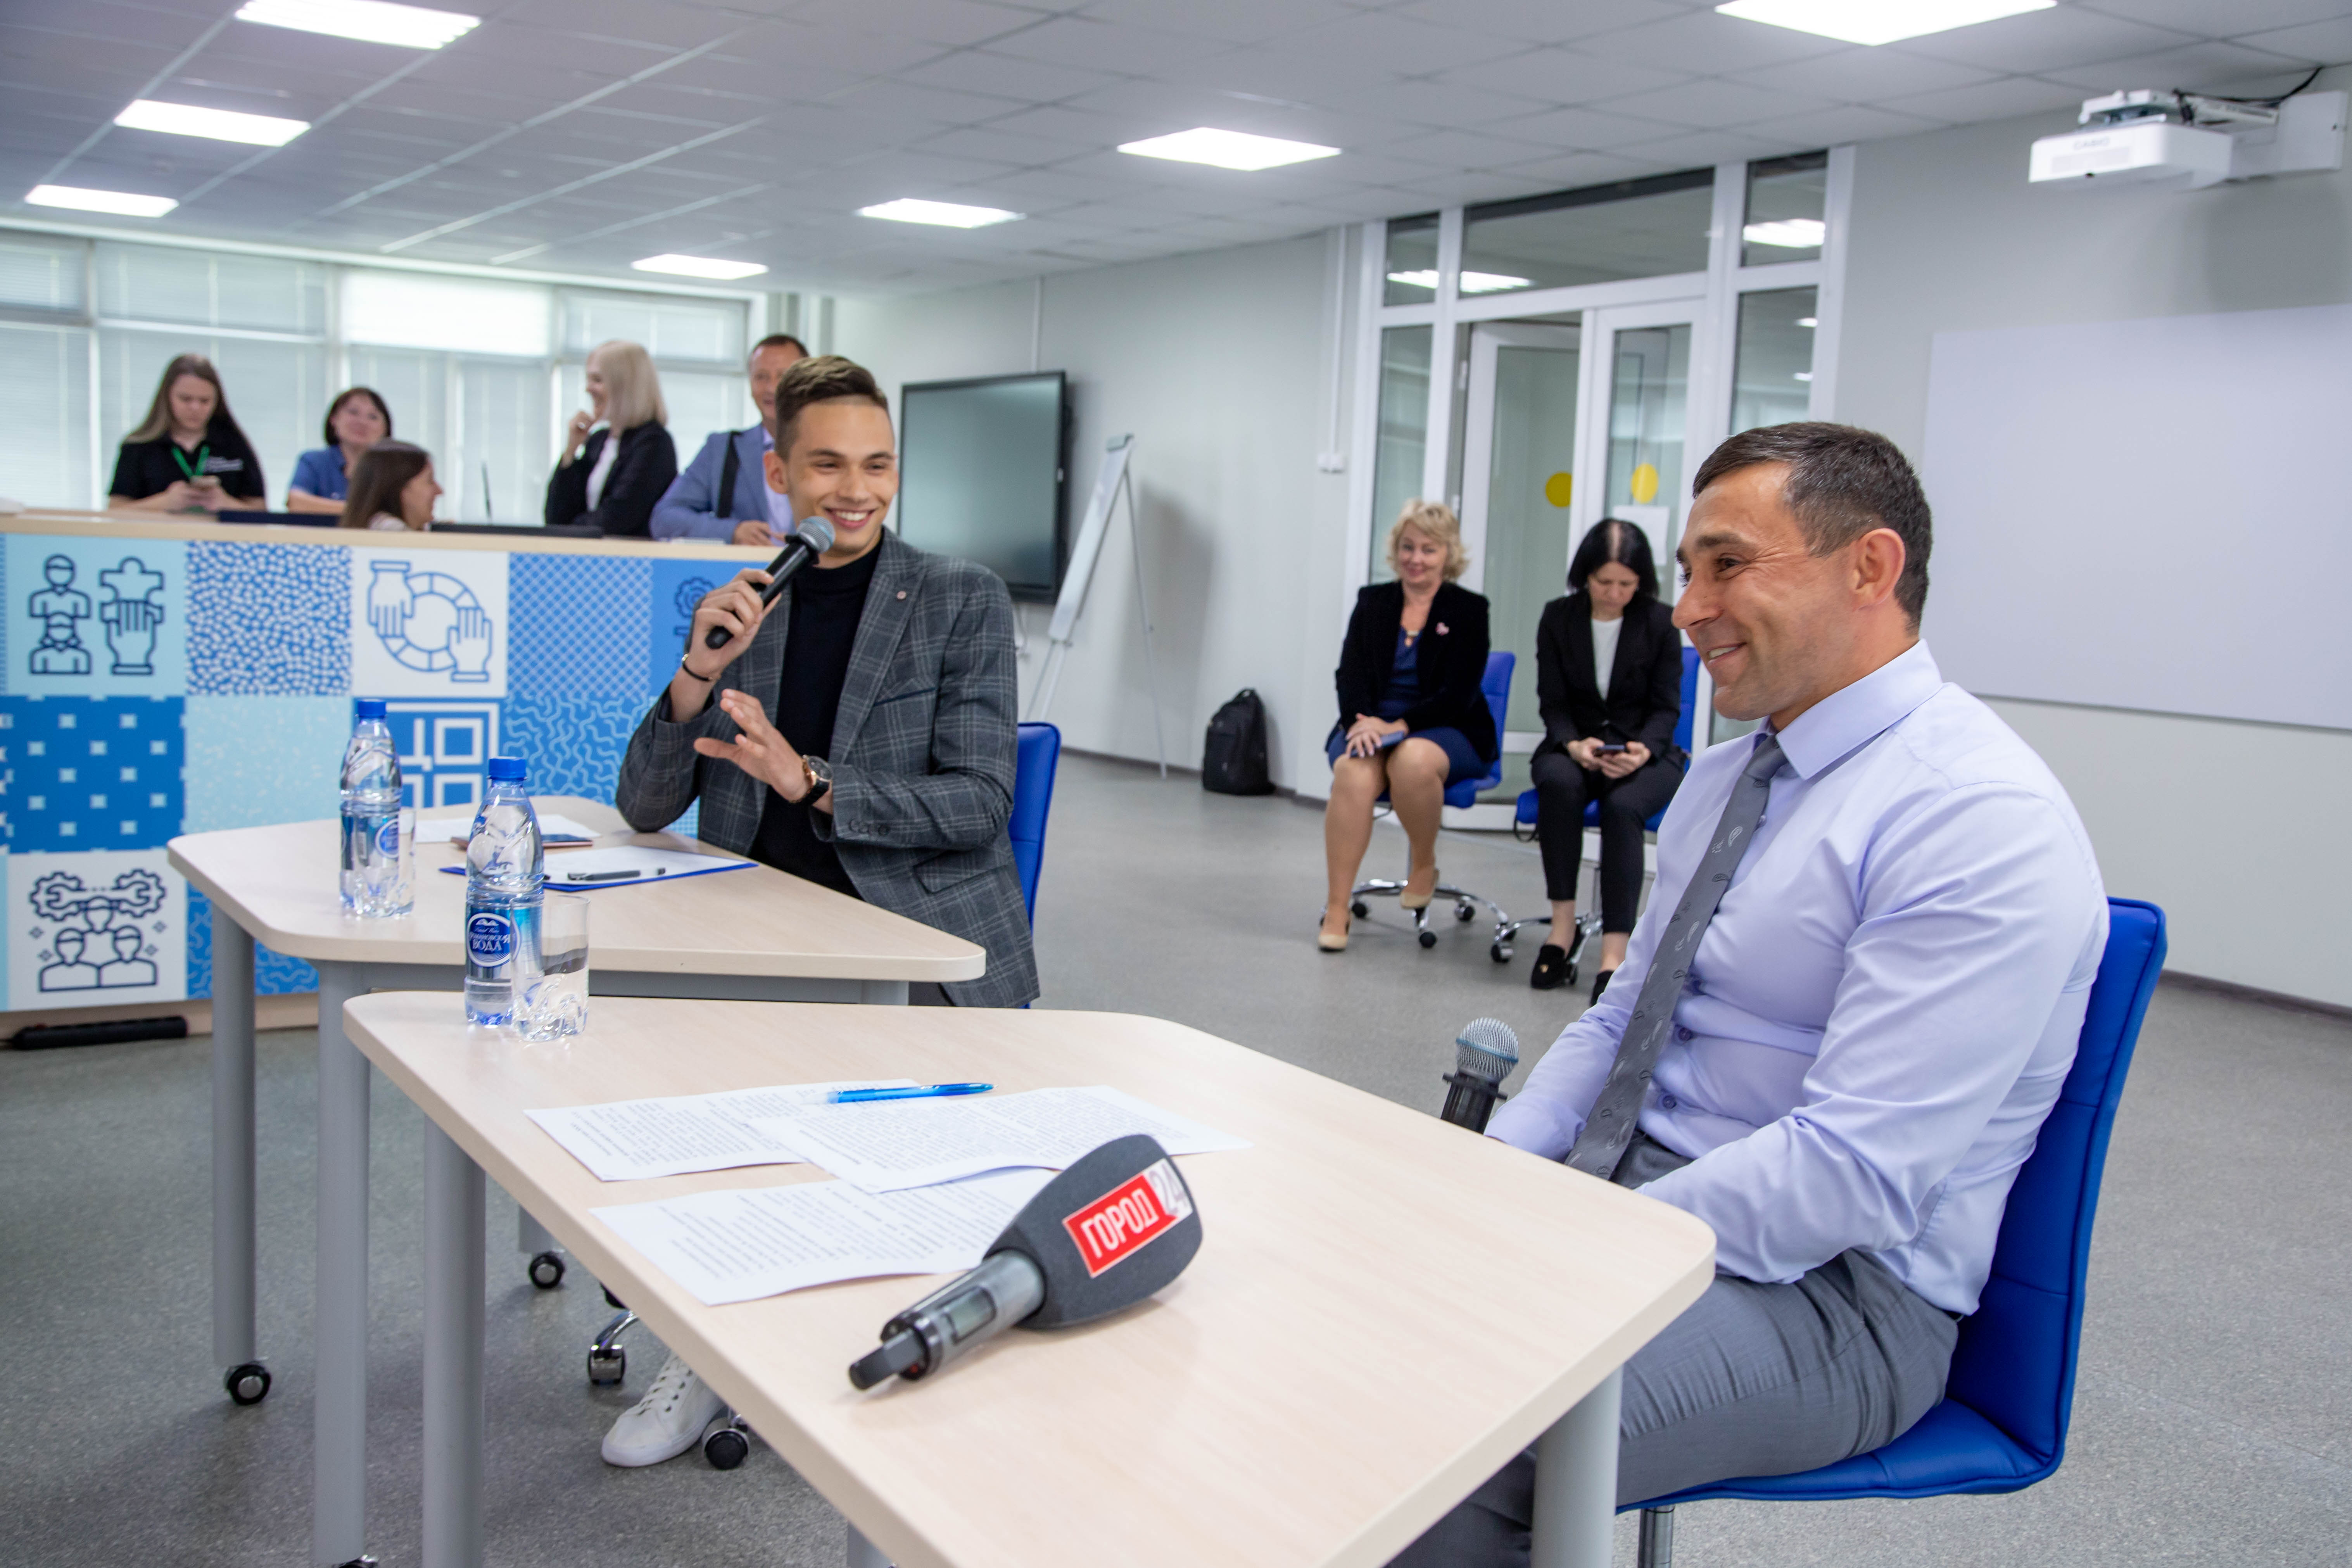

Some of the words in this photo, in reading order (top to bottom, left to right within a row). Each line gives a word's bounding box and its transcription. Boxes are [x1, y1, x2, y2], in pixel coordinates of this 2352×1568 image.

[472, 939, 503, 952] ВОДА
[1080, 1188, 1159, 1259] ГОРОД
[1149, 1163, 1188, 1214] 24
